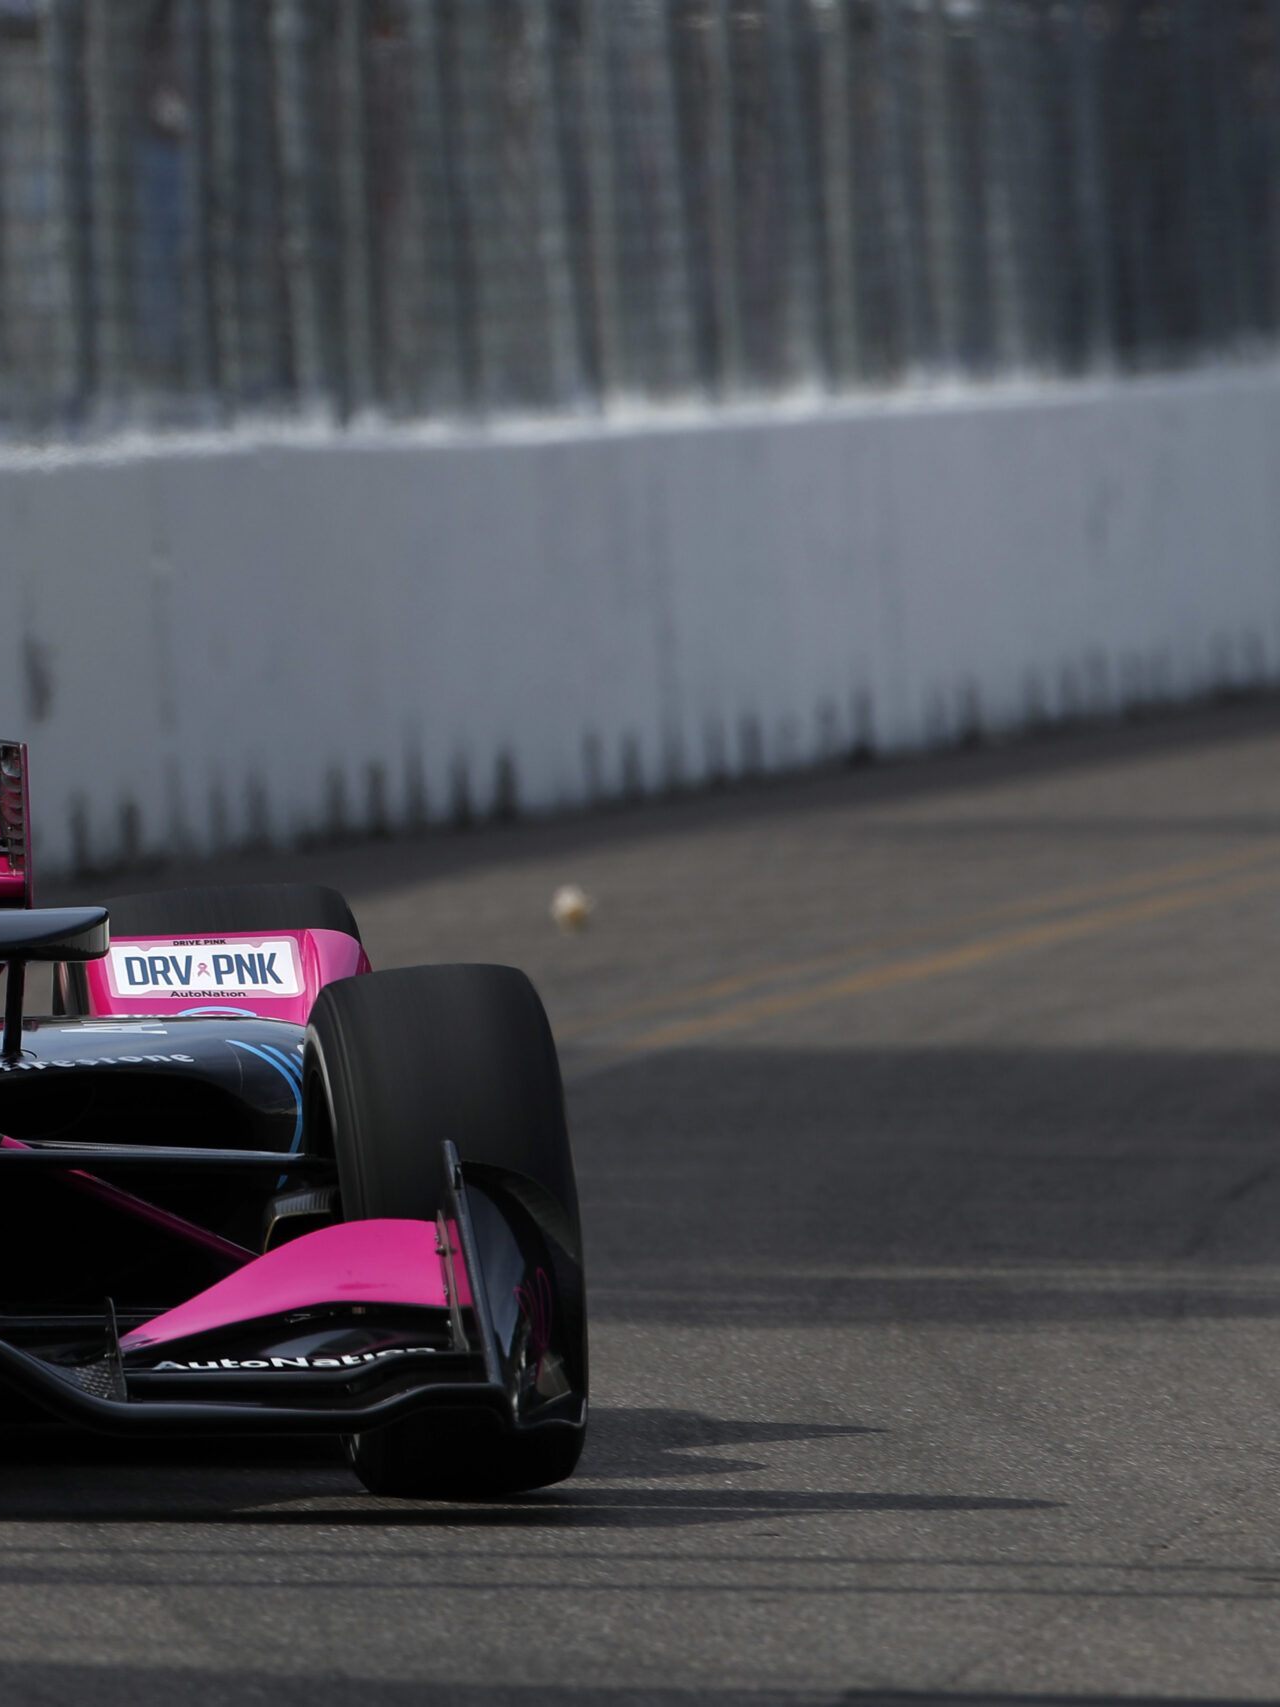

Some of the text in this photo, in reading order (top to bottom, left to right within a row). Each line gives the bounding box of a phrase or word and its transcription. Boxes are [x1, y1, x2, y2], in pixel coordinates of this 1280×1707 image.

[124, 952, 283, 986] DRV PNK
[170, 989, 246, 999] AutoNation
